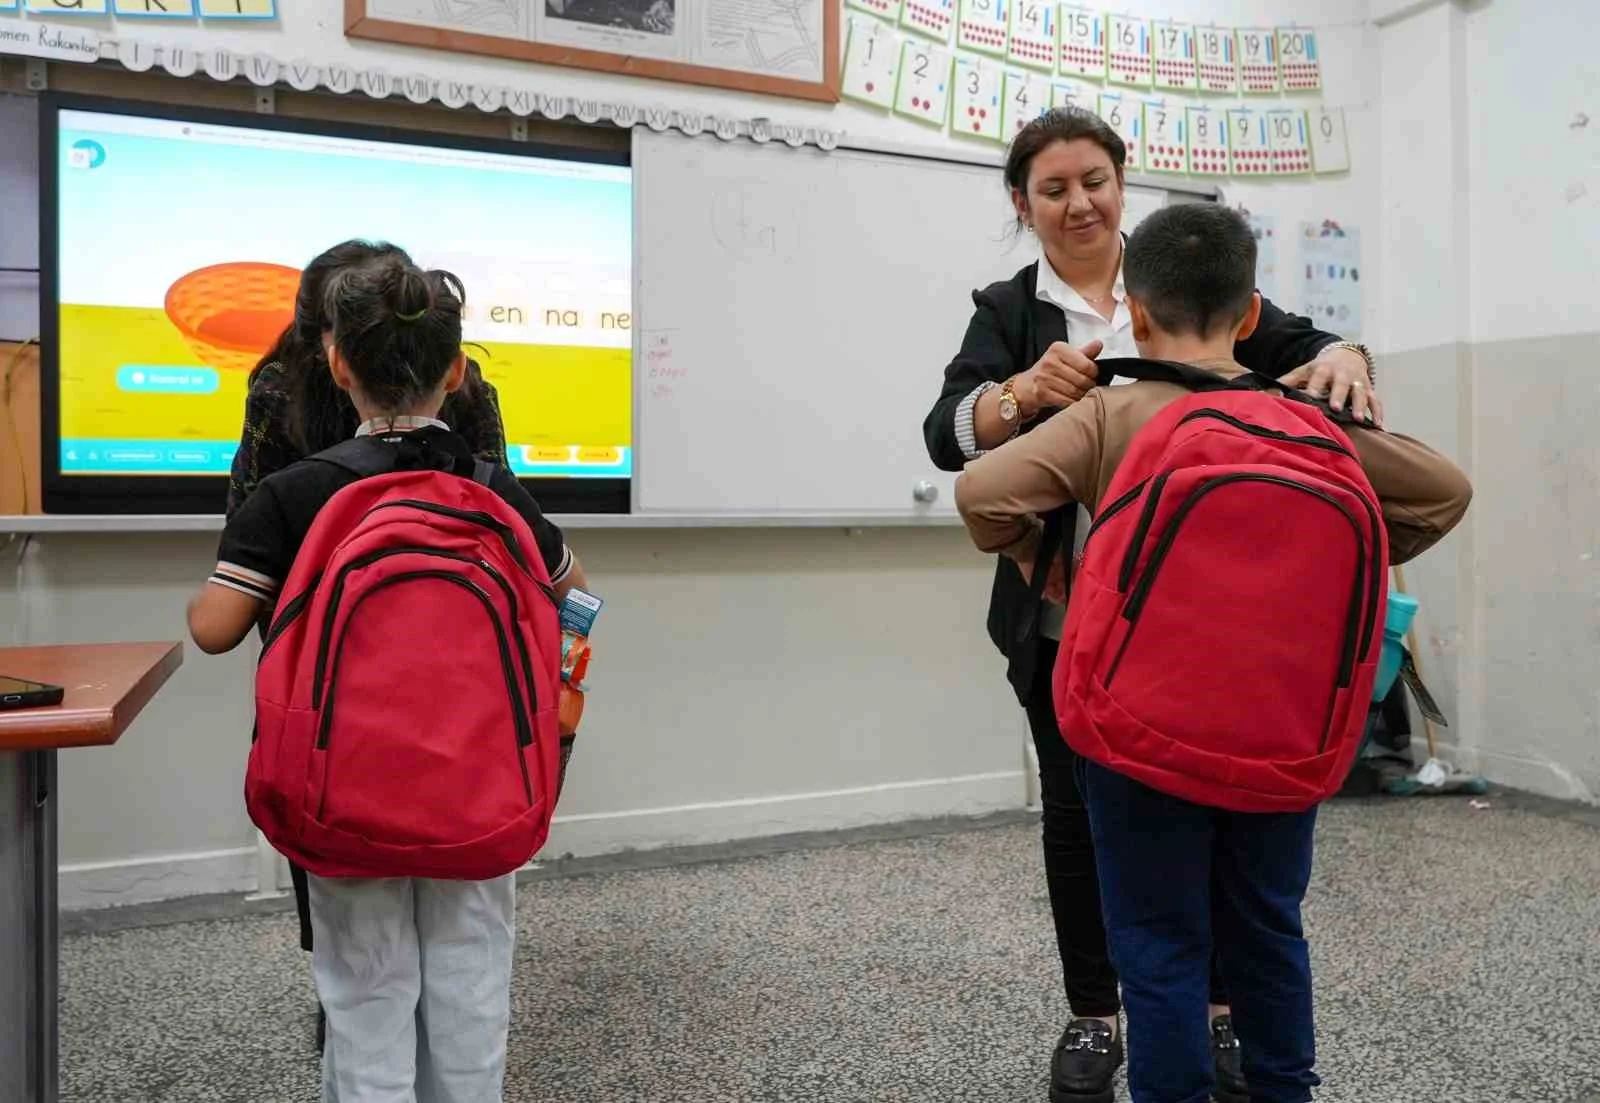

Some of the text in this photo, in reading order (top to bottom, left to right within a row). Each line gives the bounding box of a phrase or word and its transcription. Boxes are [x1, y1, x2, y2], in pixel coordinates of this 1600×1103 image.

[1018, 1, 1303, 56] 14 15 16 17 18 19 20
[171, 50, 183, 67] II
[215, 52, 230, 74] III
[253, 60, 272, 78] IV
[292, 66, 309, 84] V
[328, 67, 348, 87] VI
[366, 73, 386, 93] VII
[449, 82, 464, 100] IX
[481, 88, 492, 104] X
[867, 37, 874, 60] 1
[913, 53, 929, 78] 2
[967, 71, 980, 95] 3
[1015, 85, 1028, 107] 4
[1109, 105, 1121, 126] 6
[1155, 112, 1167, 133] 7
[1197, 116, 1208, 137] 8
[1237, 117, 1249, 138] 9
[1273, 118, 1292, 138] 10
[490, 305, 631, 330] en na ne
